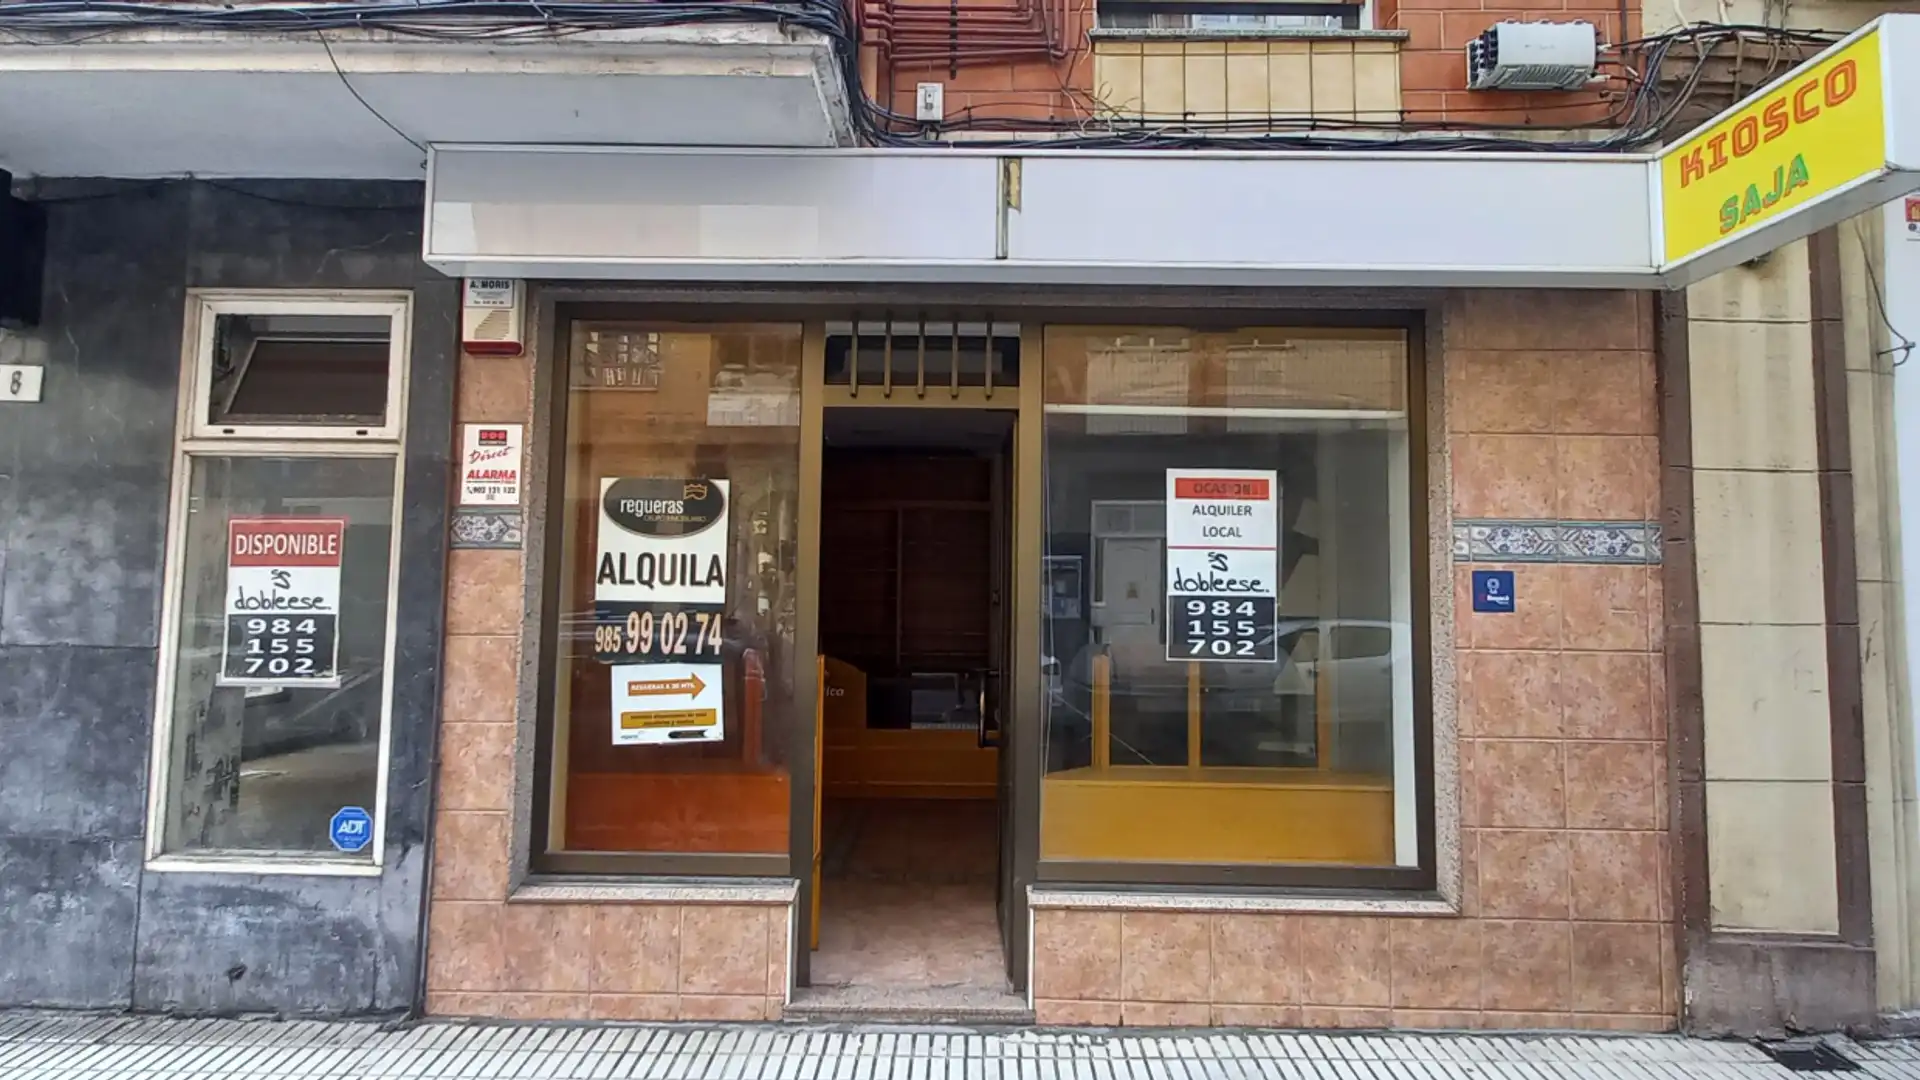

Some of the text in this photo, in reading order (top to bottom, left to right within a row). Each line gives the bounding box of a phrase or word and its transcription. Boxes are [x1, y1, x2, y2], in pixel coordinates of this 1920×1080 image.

[1680, 59, 1857, 188] KIOSCO
[1719, 153, 1810, 235] SAJA
[481, 280, 510, 289] MORIS
[469, 446, 515, 464] Direct
[467, 469, 517, 480] ALARMA
[620, 498, 684, 518] regueras
[1192, 505, 1253, 517] ALQUILER
[1203, 526, 1242, 538] LOCAL
[235, 534, 337, 556] DISPONIBLE
[597, 552, 724, 590] ALQUILA
[1187, 600, 1256, 616] 984
[247, 618, 317, 634] 984
[594, 611, 723, 655] 985 99 02 74
[1188, 620, 1256, 636] 155
[247, 638, 315, 654] 155
[1187, 639, 1256, 656] 702
[244, 658, 315, 674] 702
[337, 819, 367, 835] ADT
